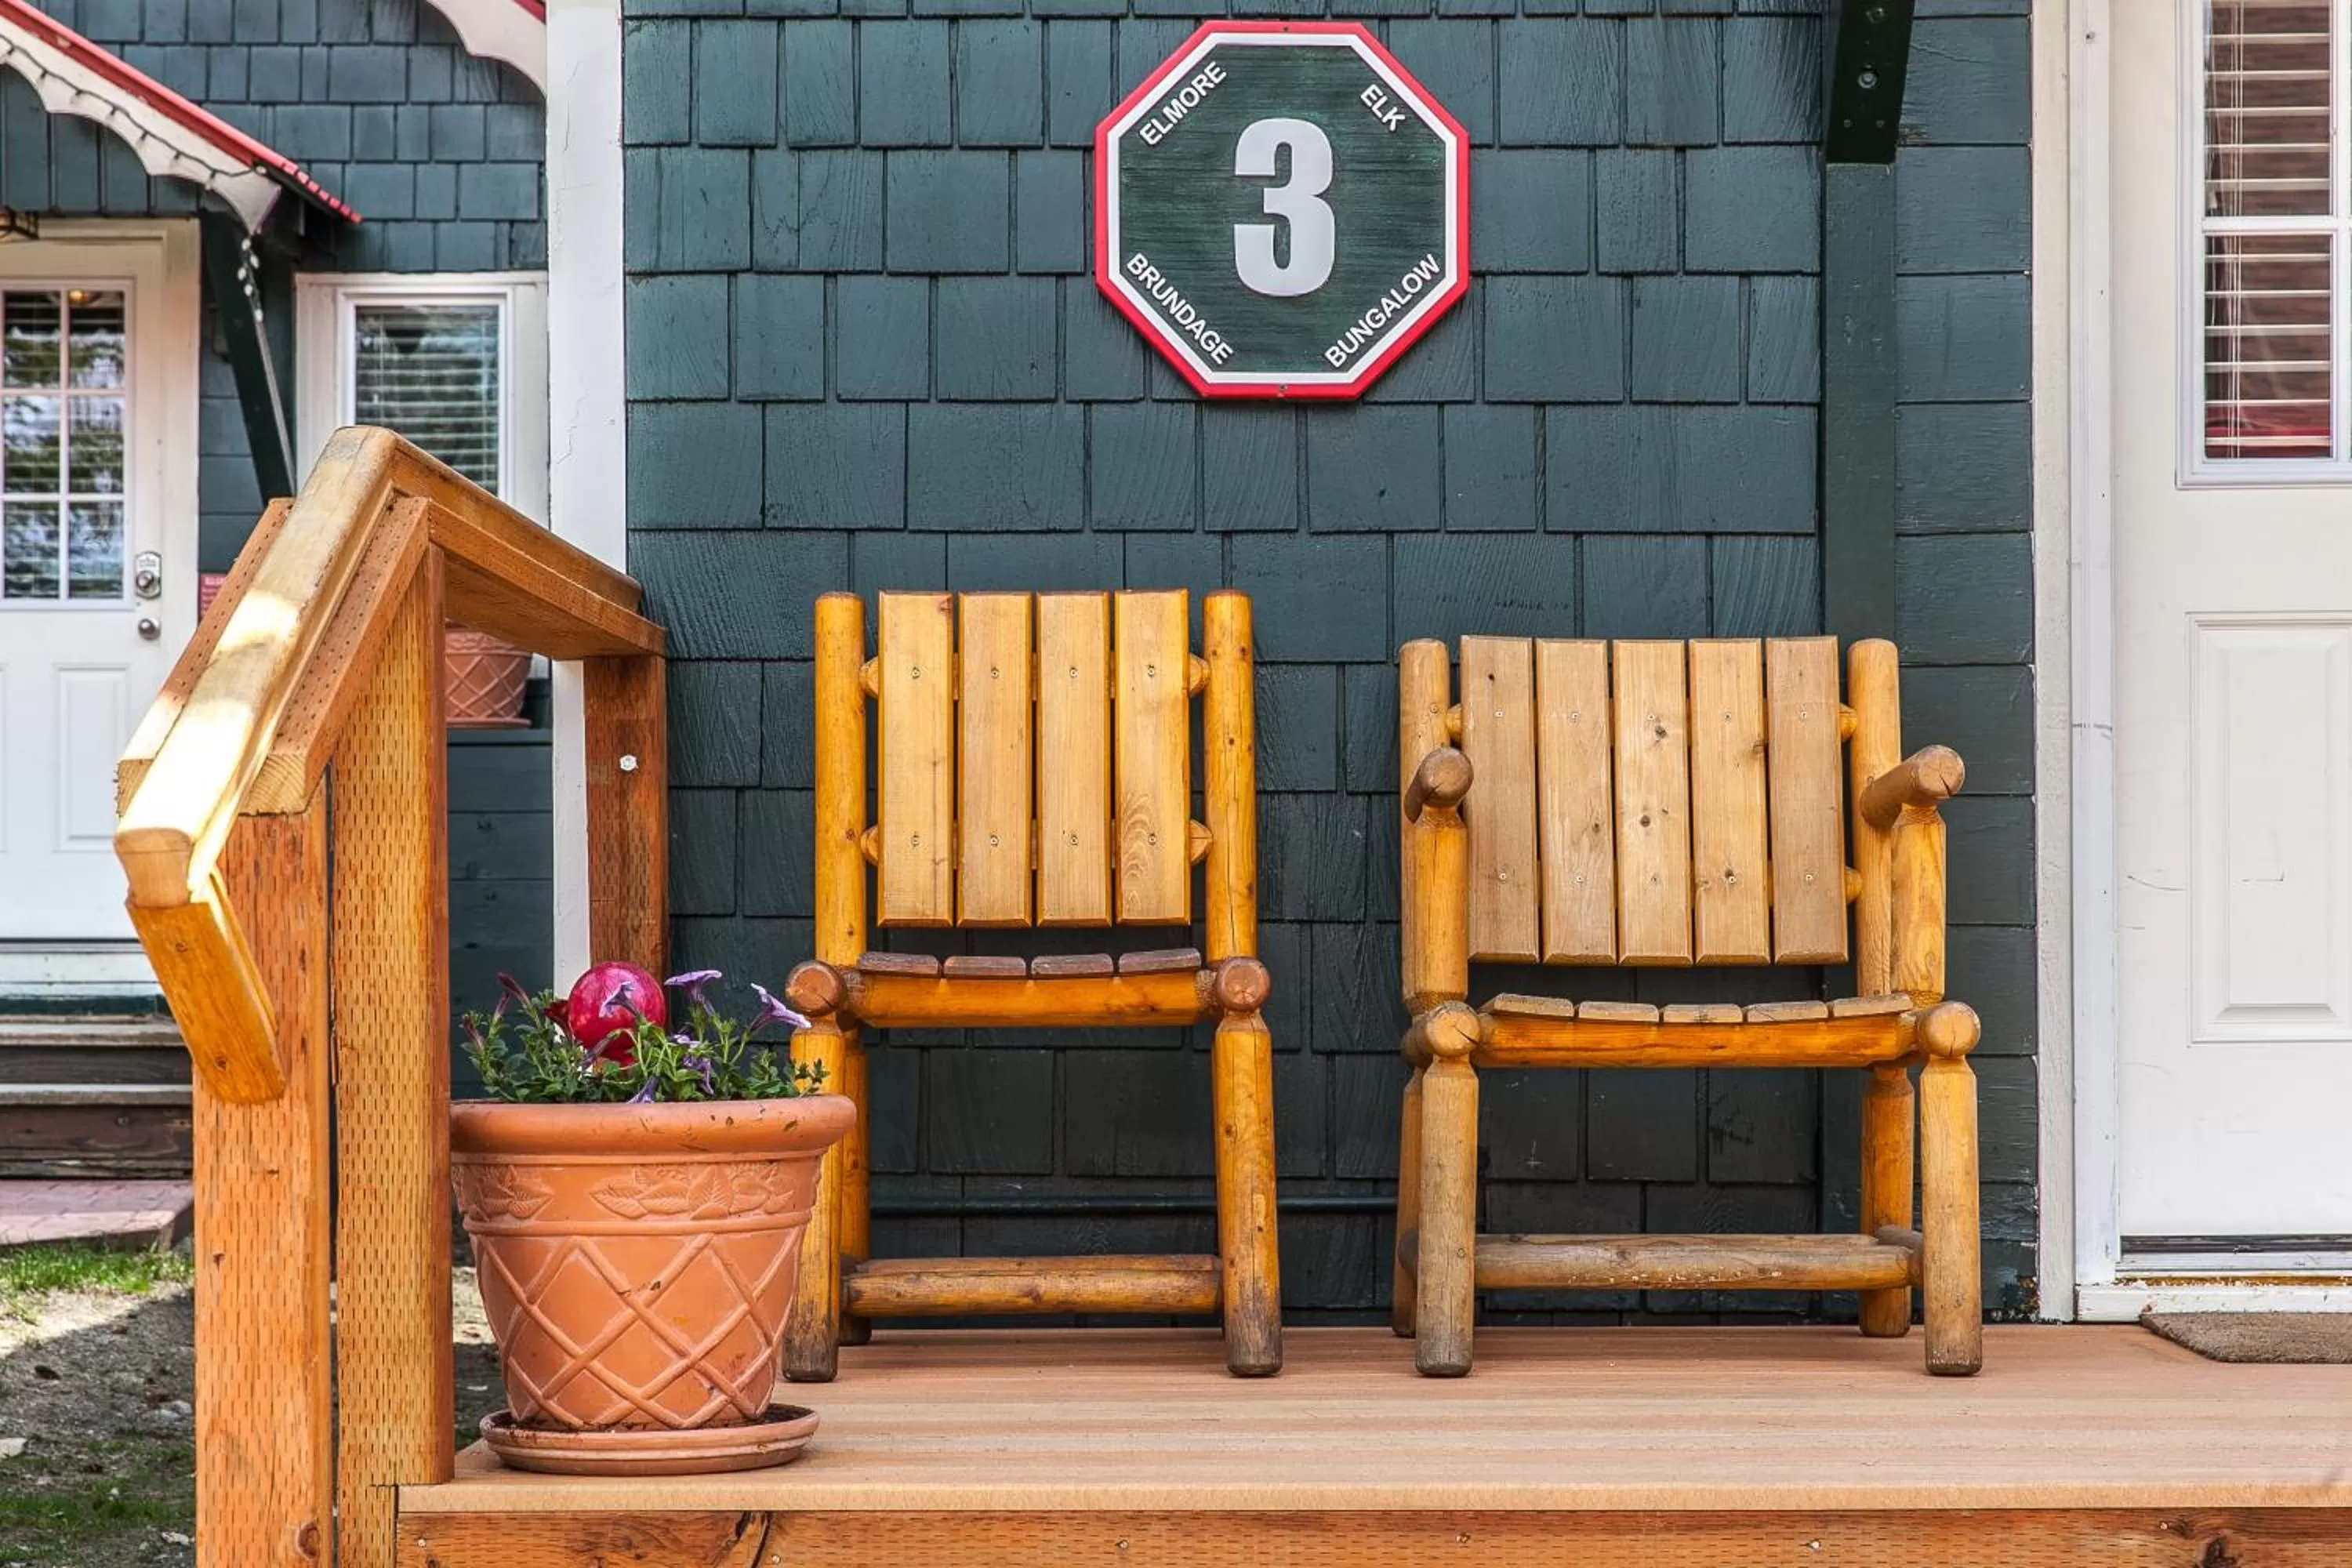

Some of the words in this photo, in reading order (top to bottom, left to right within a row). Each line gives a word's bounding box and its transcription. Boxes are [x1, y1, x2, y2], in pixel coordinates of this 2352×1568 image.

[1139, 62, 1227, 146] ELMORE
[1360, 84, 1406, 132] ELK
[1234, 118, 1335, 297] 3
[1126, 252, 1233, 365] BRUNDAGE
[1324, 253, 1440, 368] BUNGALOW
